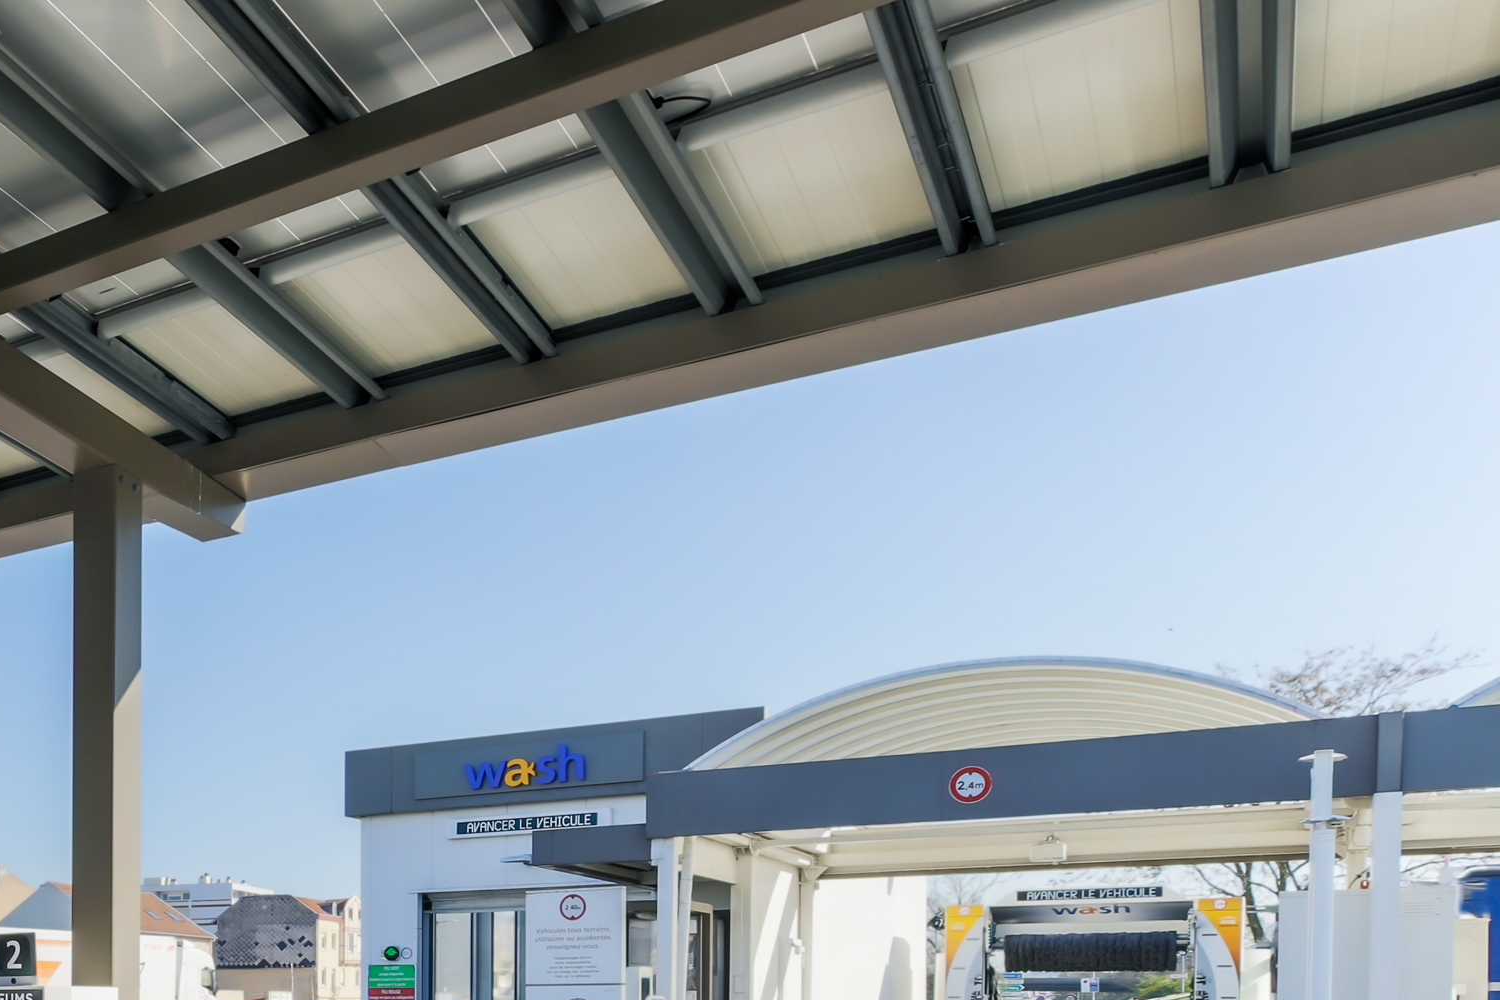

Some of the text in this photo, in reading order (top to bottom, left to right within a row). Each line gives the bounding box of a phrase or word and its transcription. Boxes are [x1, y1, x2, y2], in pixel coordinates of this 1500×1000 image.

[463, 743, 587, 790] wash
[957, 781, 984, 791] 2,4m
[466, 814, 592, 833] AVANCER LE VEHICULE
[1026, 887, 1157, 900] AVANCER LE VEHICULE
[1051, 904, 1131, 915] wash
[5, 940, 23, 970] 2
